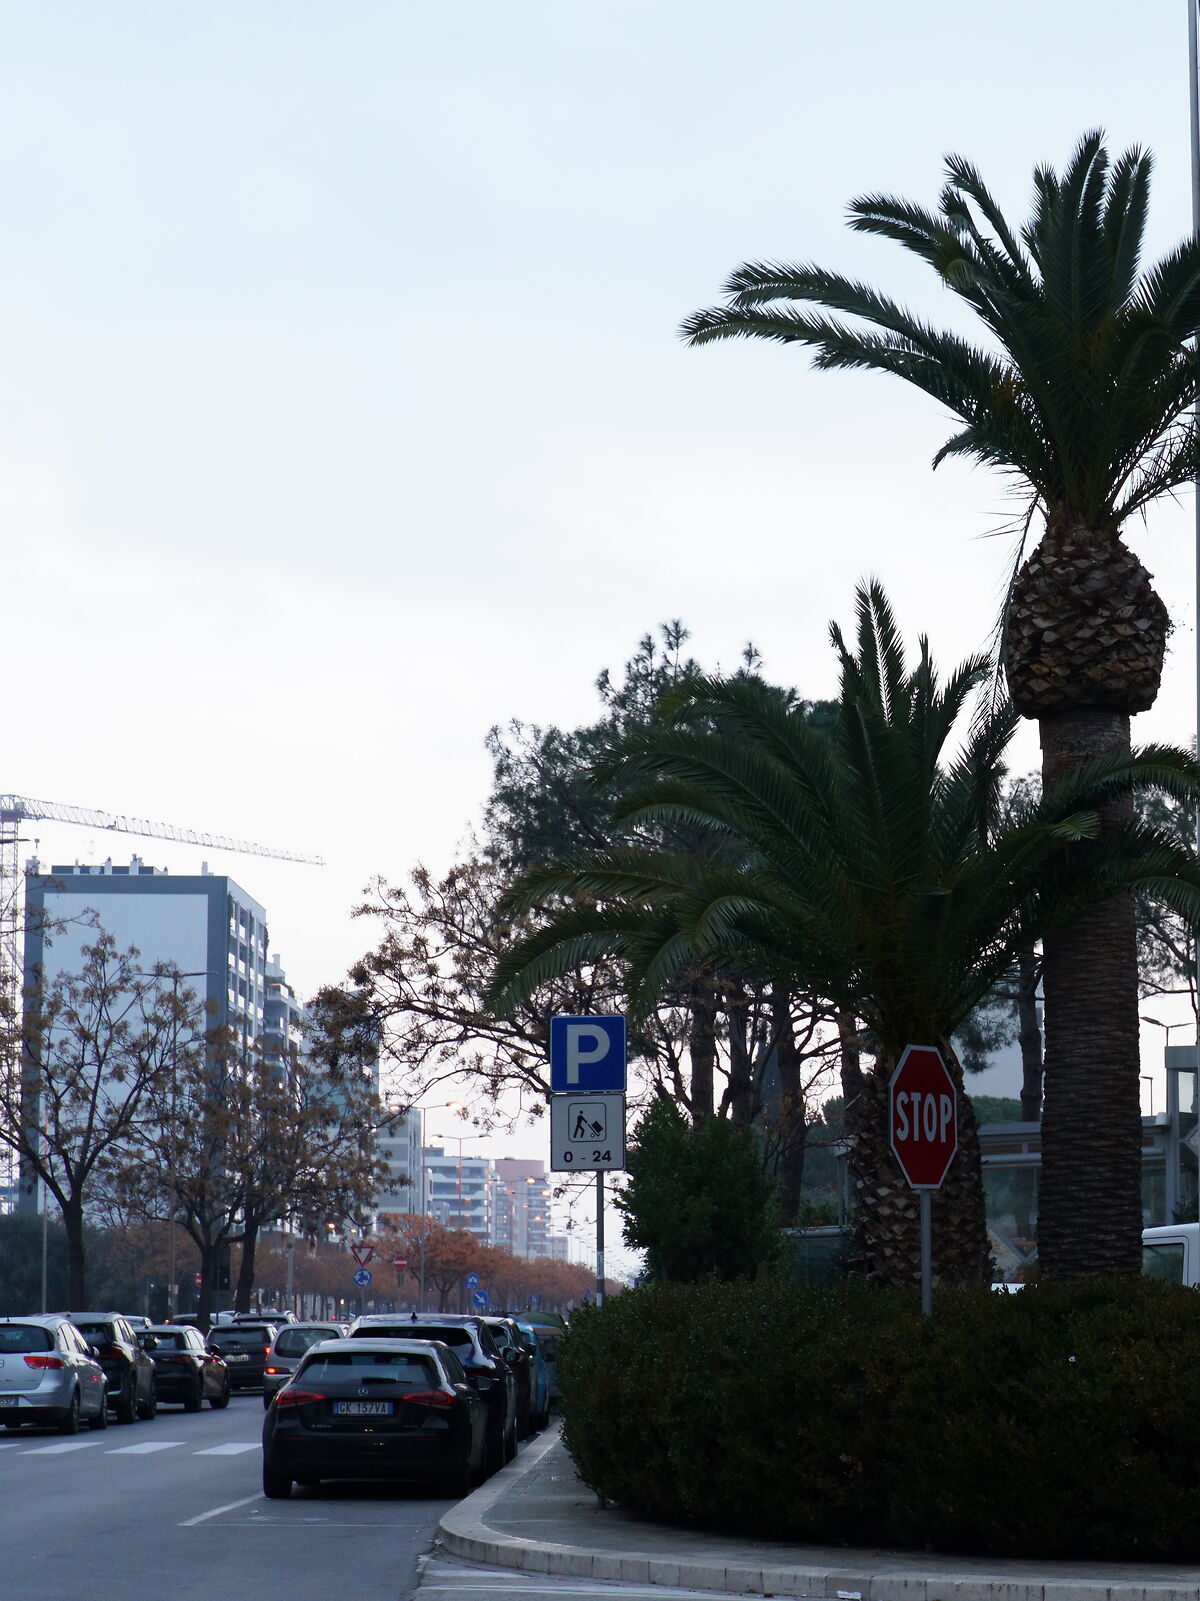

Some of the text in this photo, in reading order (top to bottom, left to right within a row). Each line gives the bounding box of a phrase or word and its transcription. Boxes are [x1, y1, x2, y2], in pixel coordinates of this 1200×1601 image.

[566, 1024, 610, 1084] P
[896, 1091, 953, 1143] STOP
[563, 1151, 573, 1163] 0
[592, 1150, 612, 1163] 24
